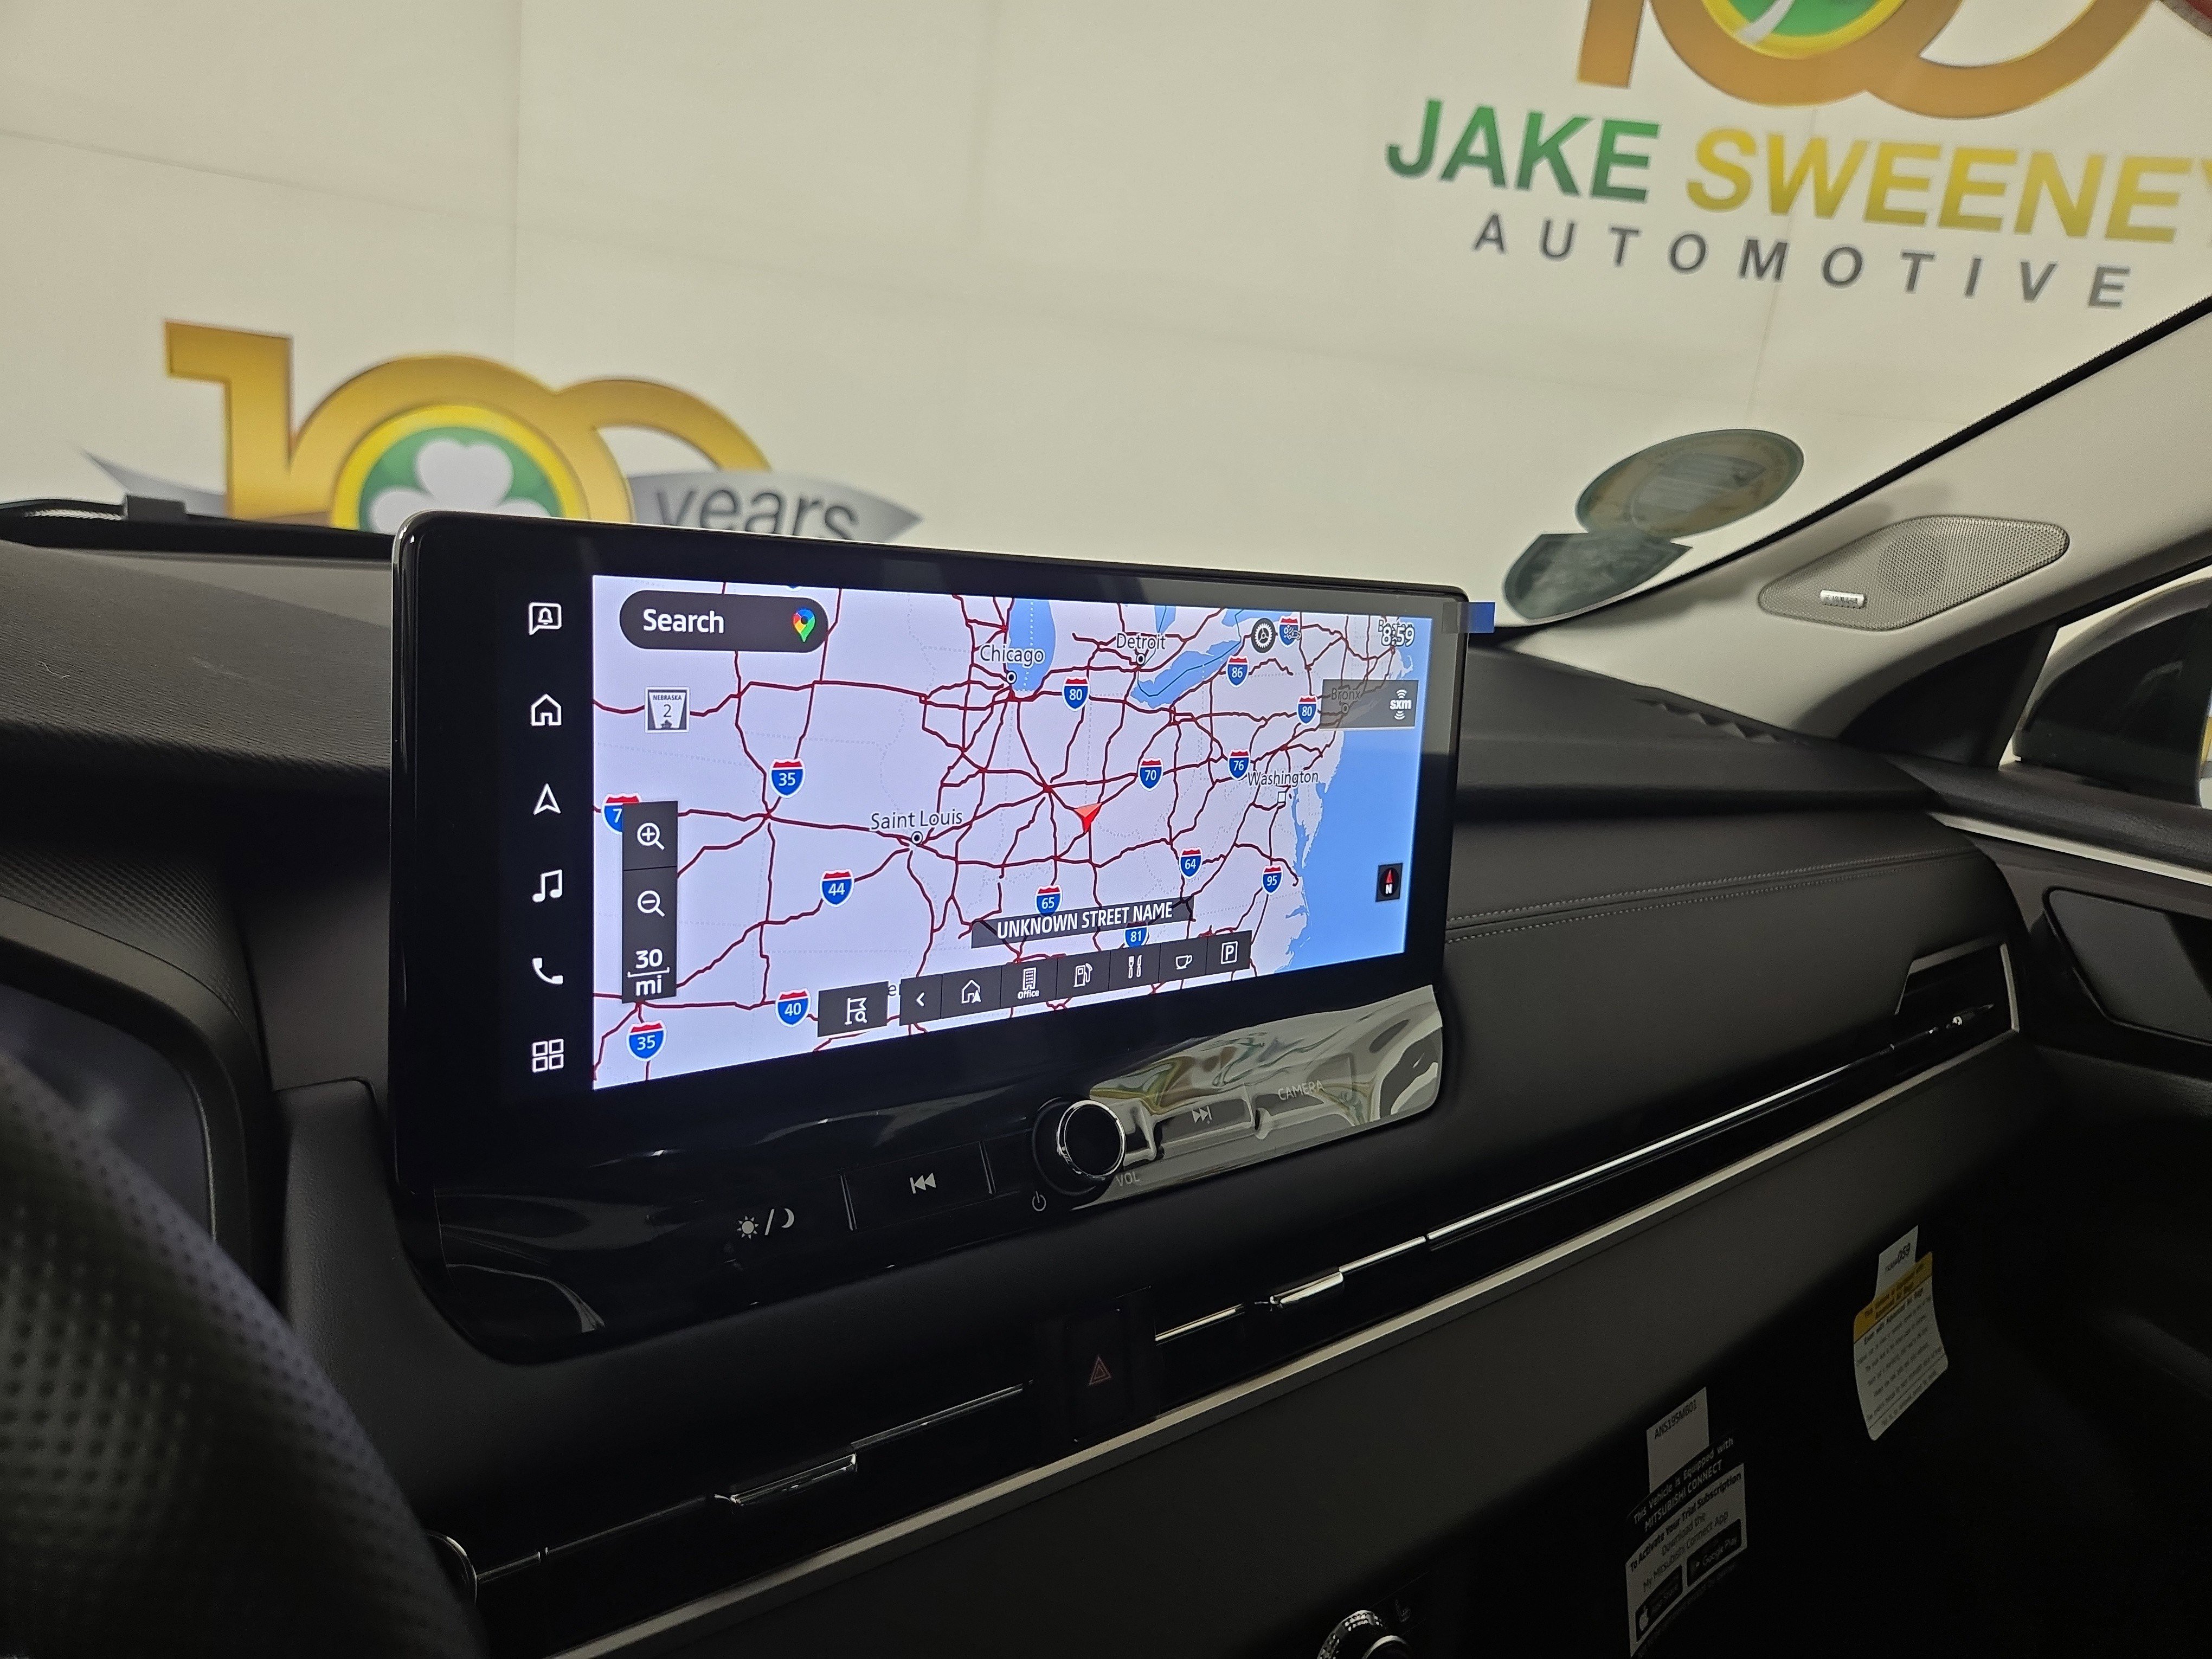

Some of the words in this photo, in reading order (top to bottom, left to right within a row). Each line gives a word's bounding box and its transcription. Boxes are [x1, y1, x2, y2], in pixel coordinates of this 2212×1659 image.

[1387, 98, 1661, 202] JAKE
[1687, 126, 2212, 243] SWEENE
[1473, 214, 2130, 308] AUTOMOTIVE
[643, 609, 724, 633] Search
[1116, 633, 1166, 651] Detroit
[1381, 627, 1415, 647] 8:59
[980, 645, 1044, 665] Chicago
[1231, 666, 1243, 679] 86
[1069, 688, 1083, 700] 80
[1331, 687, 1361, 701] Bronx
[663, 703, 672, 718] 2
[1301, 705, 1313, 717] 80
[1233, 760, 1245, 771] 76
[777, 773, 796, 786] 35
[1144, 769, 1157, 782] 70
[1248, 770, 1319, 787] Washington
[613, 808, 622, 823] 7
[871, 812, 915, 830] Saint
[920, 808, 962, 827] Louis
[1185, 858, 1197, 870] 64
[1266, 876, 1278, 886] 95
[828, 882, 845, 896] 44
[1041, 897, 1055, 910] 65
[998, 915, 1078, 940] UNKNOWN
[1082, 906, 1130, 929] STREET
[1133, 901, 1173, 922] NAME
[1130, 930, 1141, 942] 81
[635, 949, 663, 969] 30
[636, 975, 662, 996] mi
[1018, 989, 1040, 1000] Office
[785, 1002, 802, 1017] 40
[636, 1036, 655, 1051] 35
[1278, 1081, 1323, 1102] CAMERA
[1115, 1172, 1141, 1187] VOL
[1644, 1490, 1687, 1532] MITSUBISHI
[1688, 1459, 1722, 1494] CONNECT
[1638, 1532, 1665, 1560] Activate
[1697, 1472, 1742, 1508] Subscription
